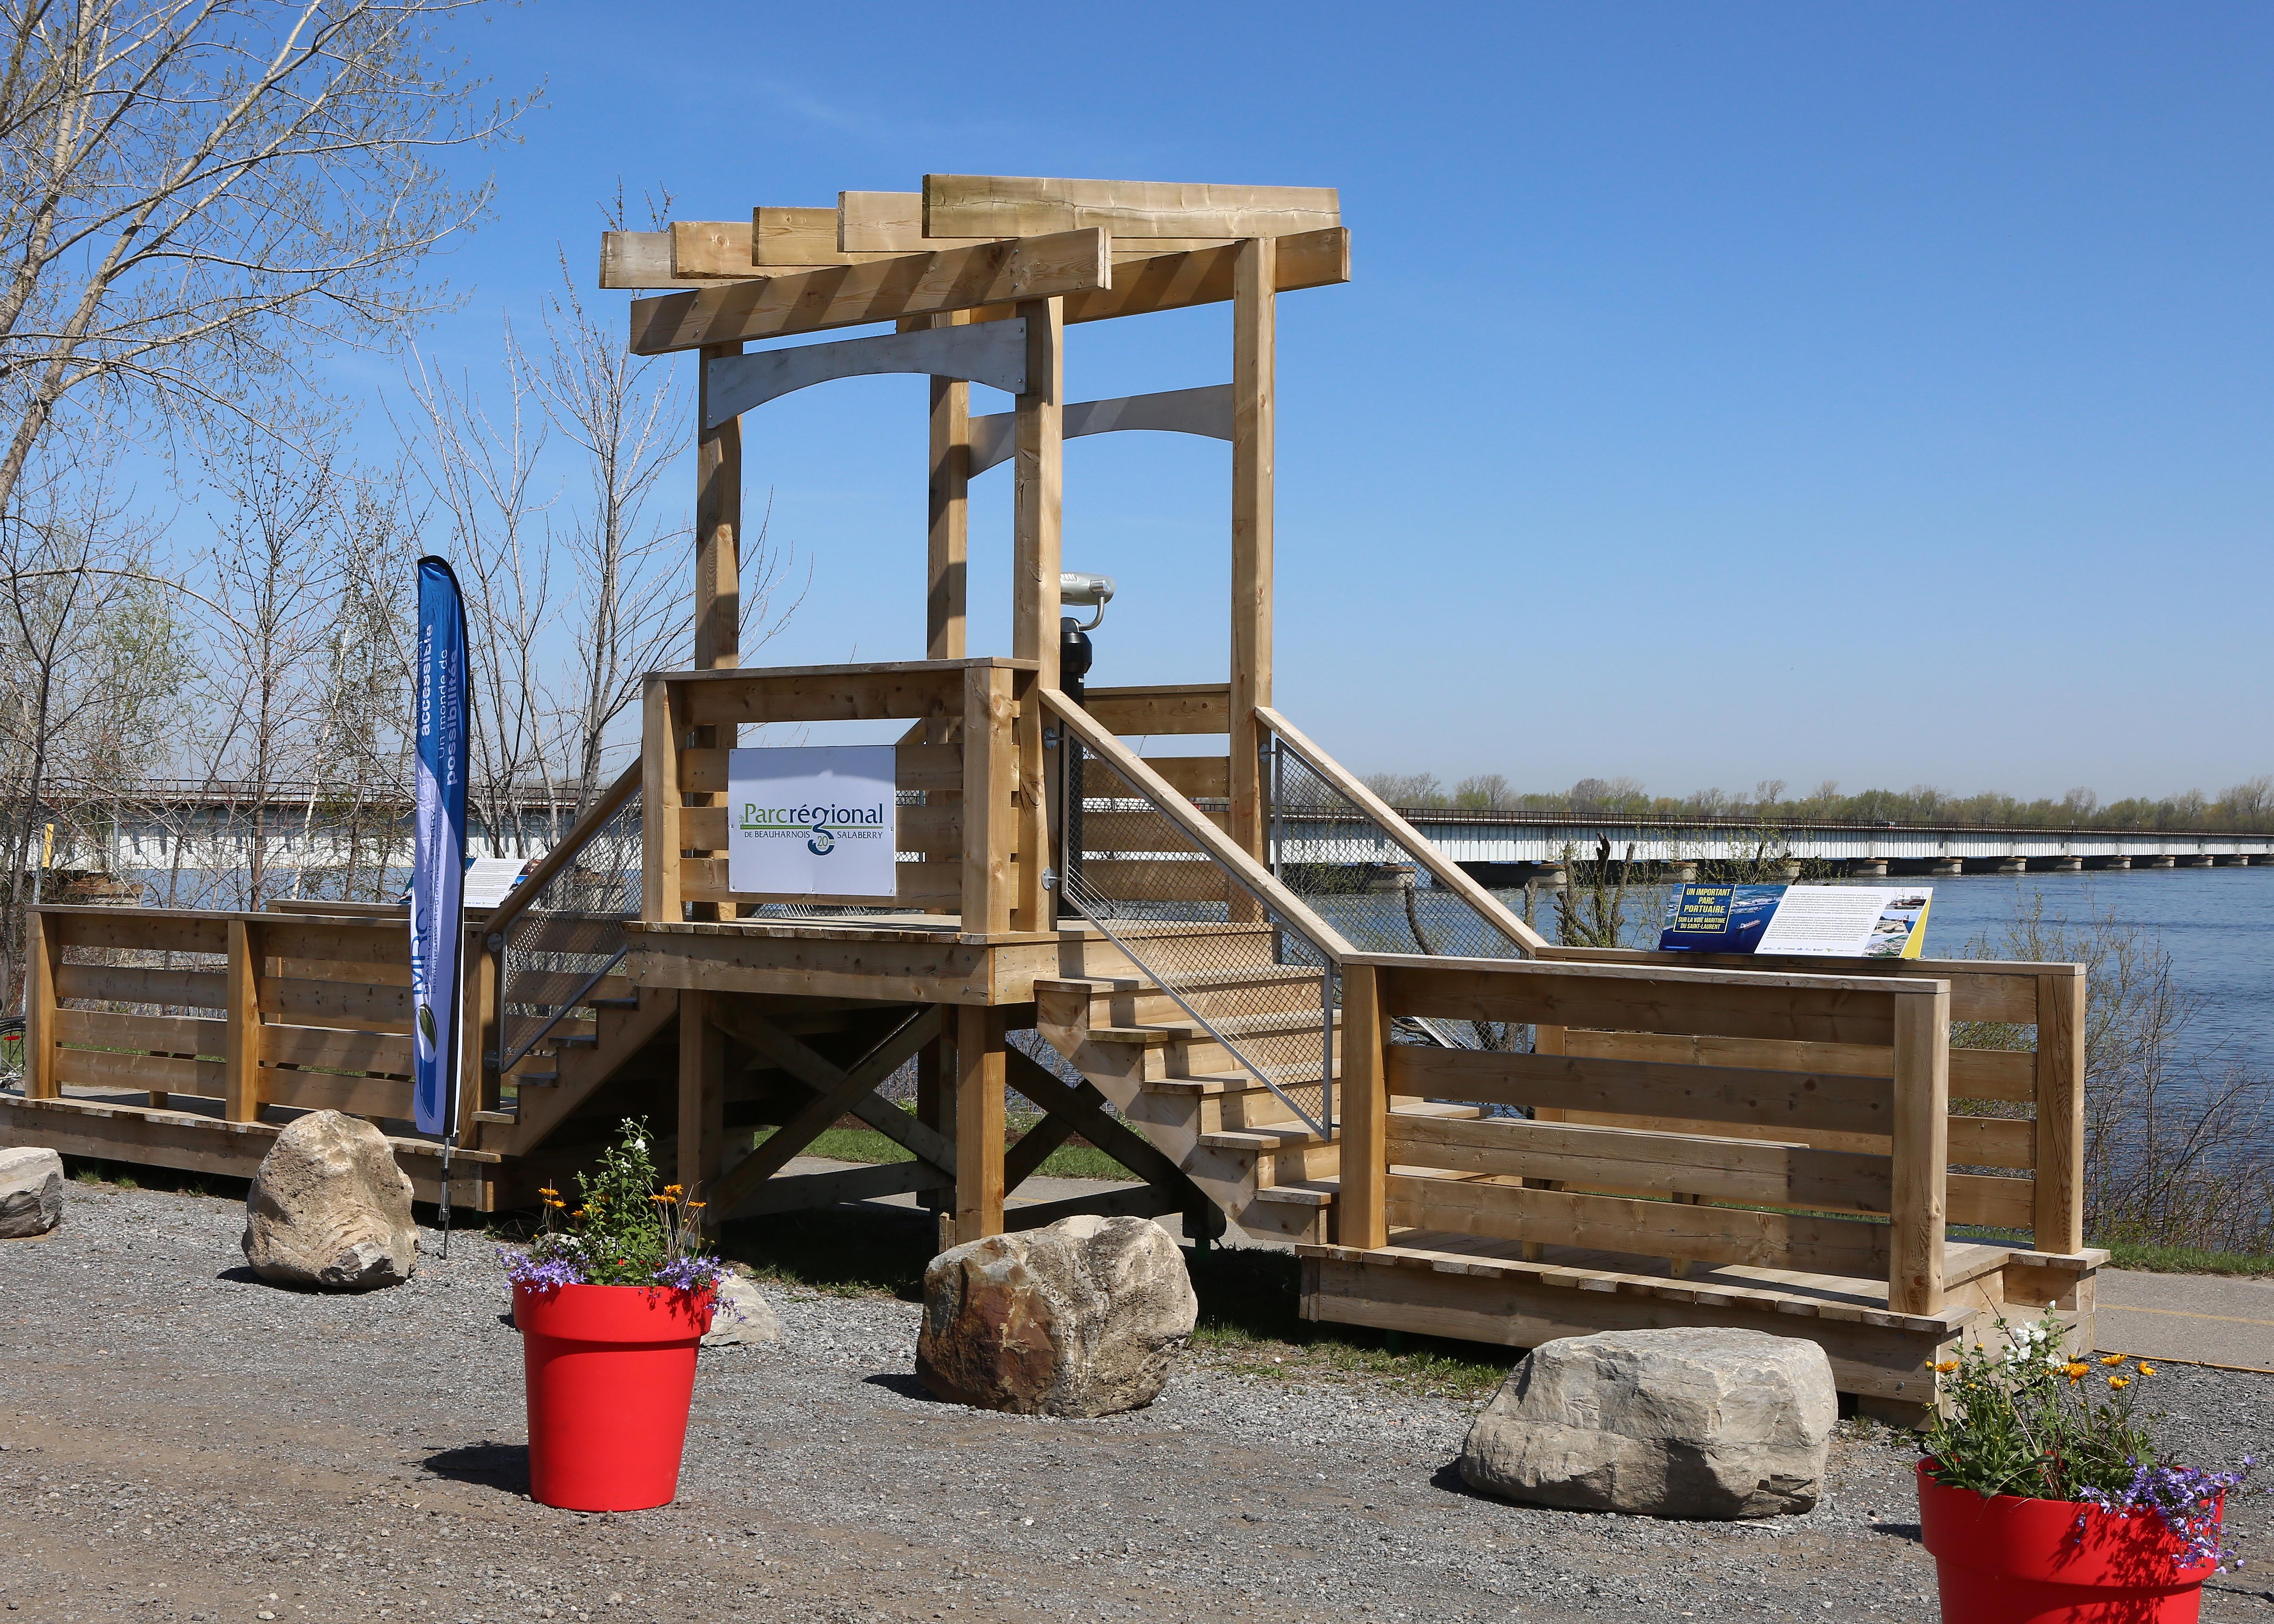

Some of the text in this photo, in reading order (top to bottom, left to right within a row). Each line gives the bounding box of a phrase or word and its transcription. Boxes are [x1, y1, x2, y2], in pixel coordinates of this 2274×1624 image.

[438, 675, 447, 730] monde
[447, 649, 458, 786] possibilités
[438, 736, 445, 759] Un
[817, 836, 828, 847] 20
[837, 831, 883, 839] SALABERRY
[1686, 888, 1731, 897] UN IMPORTANT
[1684, 905, 1725, 913] PORTUAIRE
[411, 907, 428, 995] MRC
